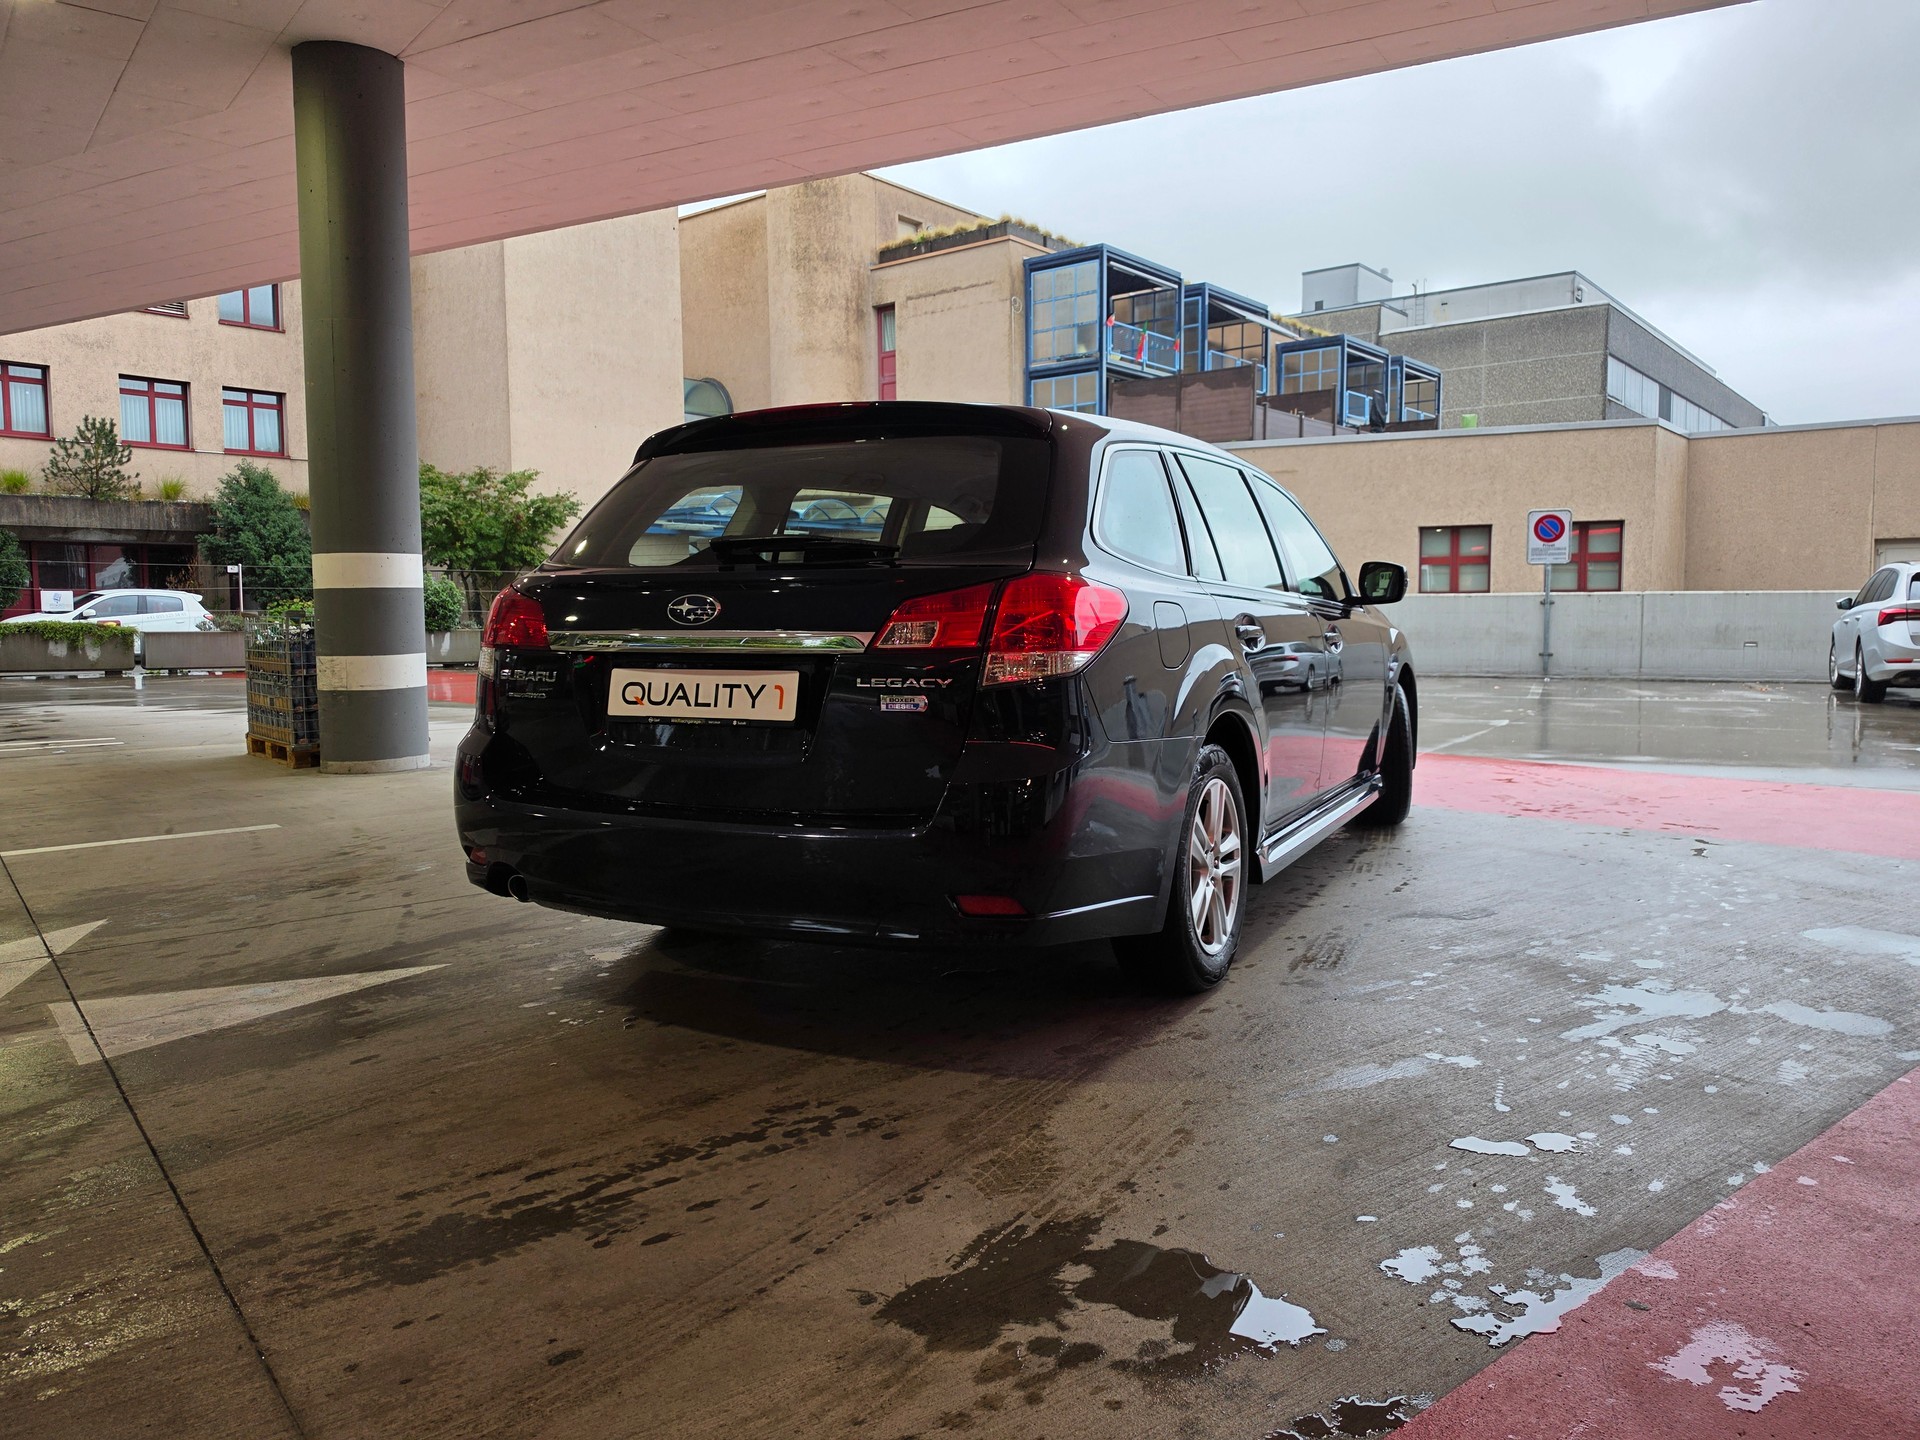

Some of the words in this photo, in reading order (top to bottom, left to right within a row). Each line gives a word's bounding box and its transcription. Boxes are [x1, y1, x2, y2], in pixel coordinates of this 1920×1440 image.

[500, 669, 557, 682] SUBARU
[856, 677, 953, 688] LEGACY
[621, 681, 767, 709] QUALITY
[774, 684, 785, 710] 1
